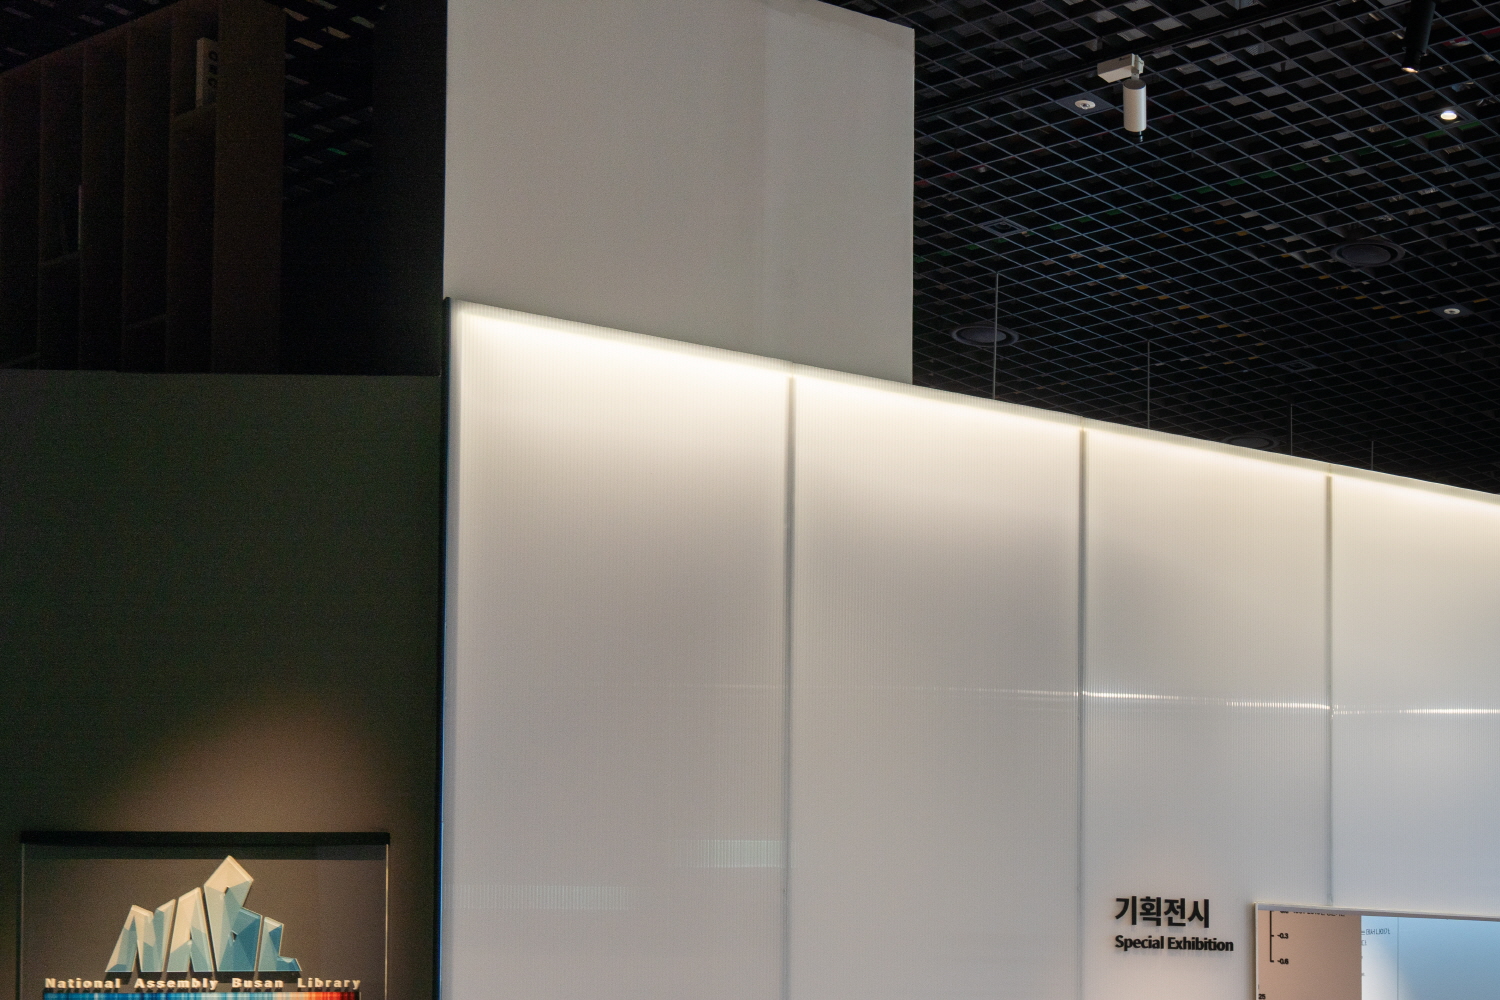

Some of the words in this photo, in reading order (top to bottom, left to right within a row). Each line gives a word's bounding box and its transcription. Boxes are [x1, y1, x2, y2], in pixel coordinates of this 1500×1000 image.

[1115, 896, 1210, 929] 기획전시
[1115, 935, 1164, 951] Special
[1167, 937, 1234, 951] Exhibition
[45, 977, 121, 989] National
[134, 978, 219, 990] Assembly
[231, 978, 284, 988] Busan
[297, 978, 361, 990] Library
